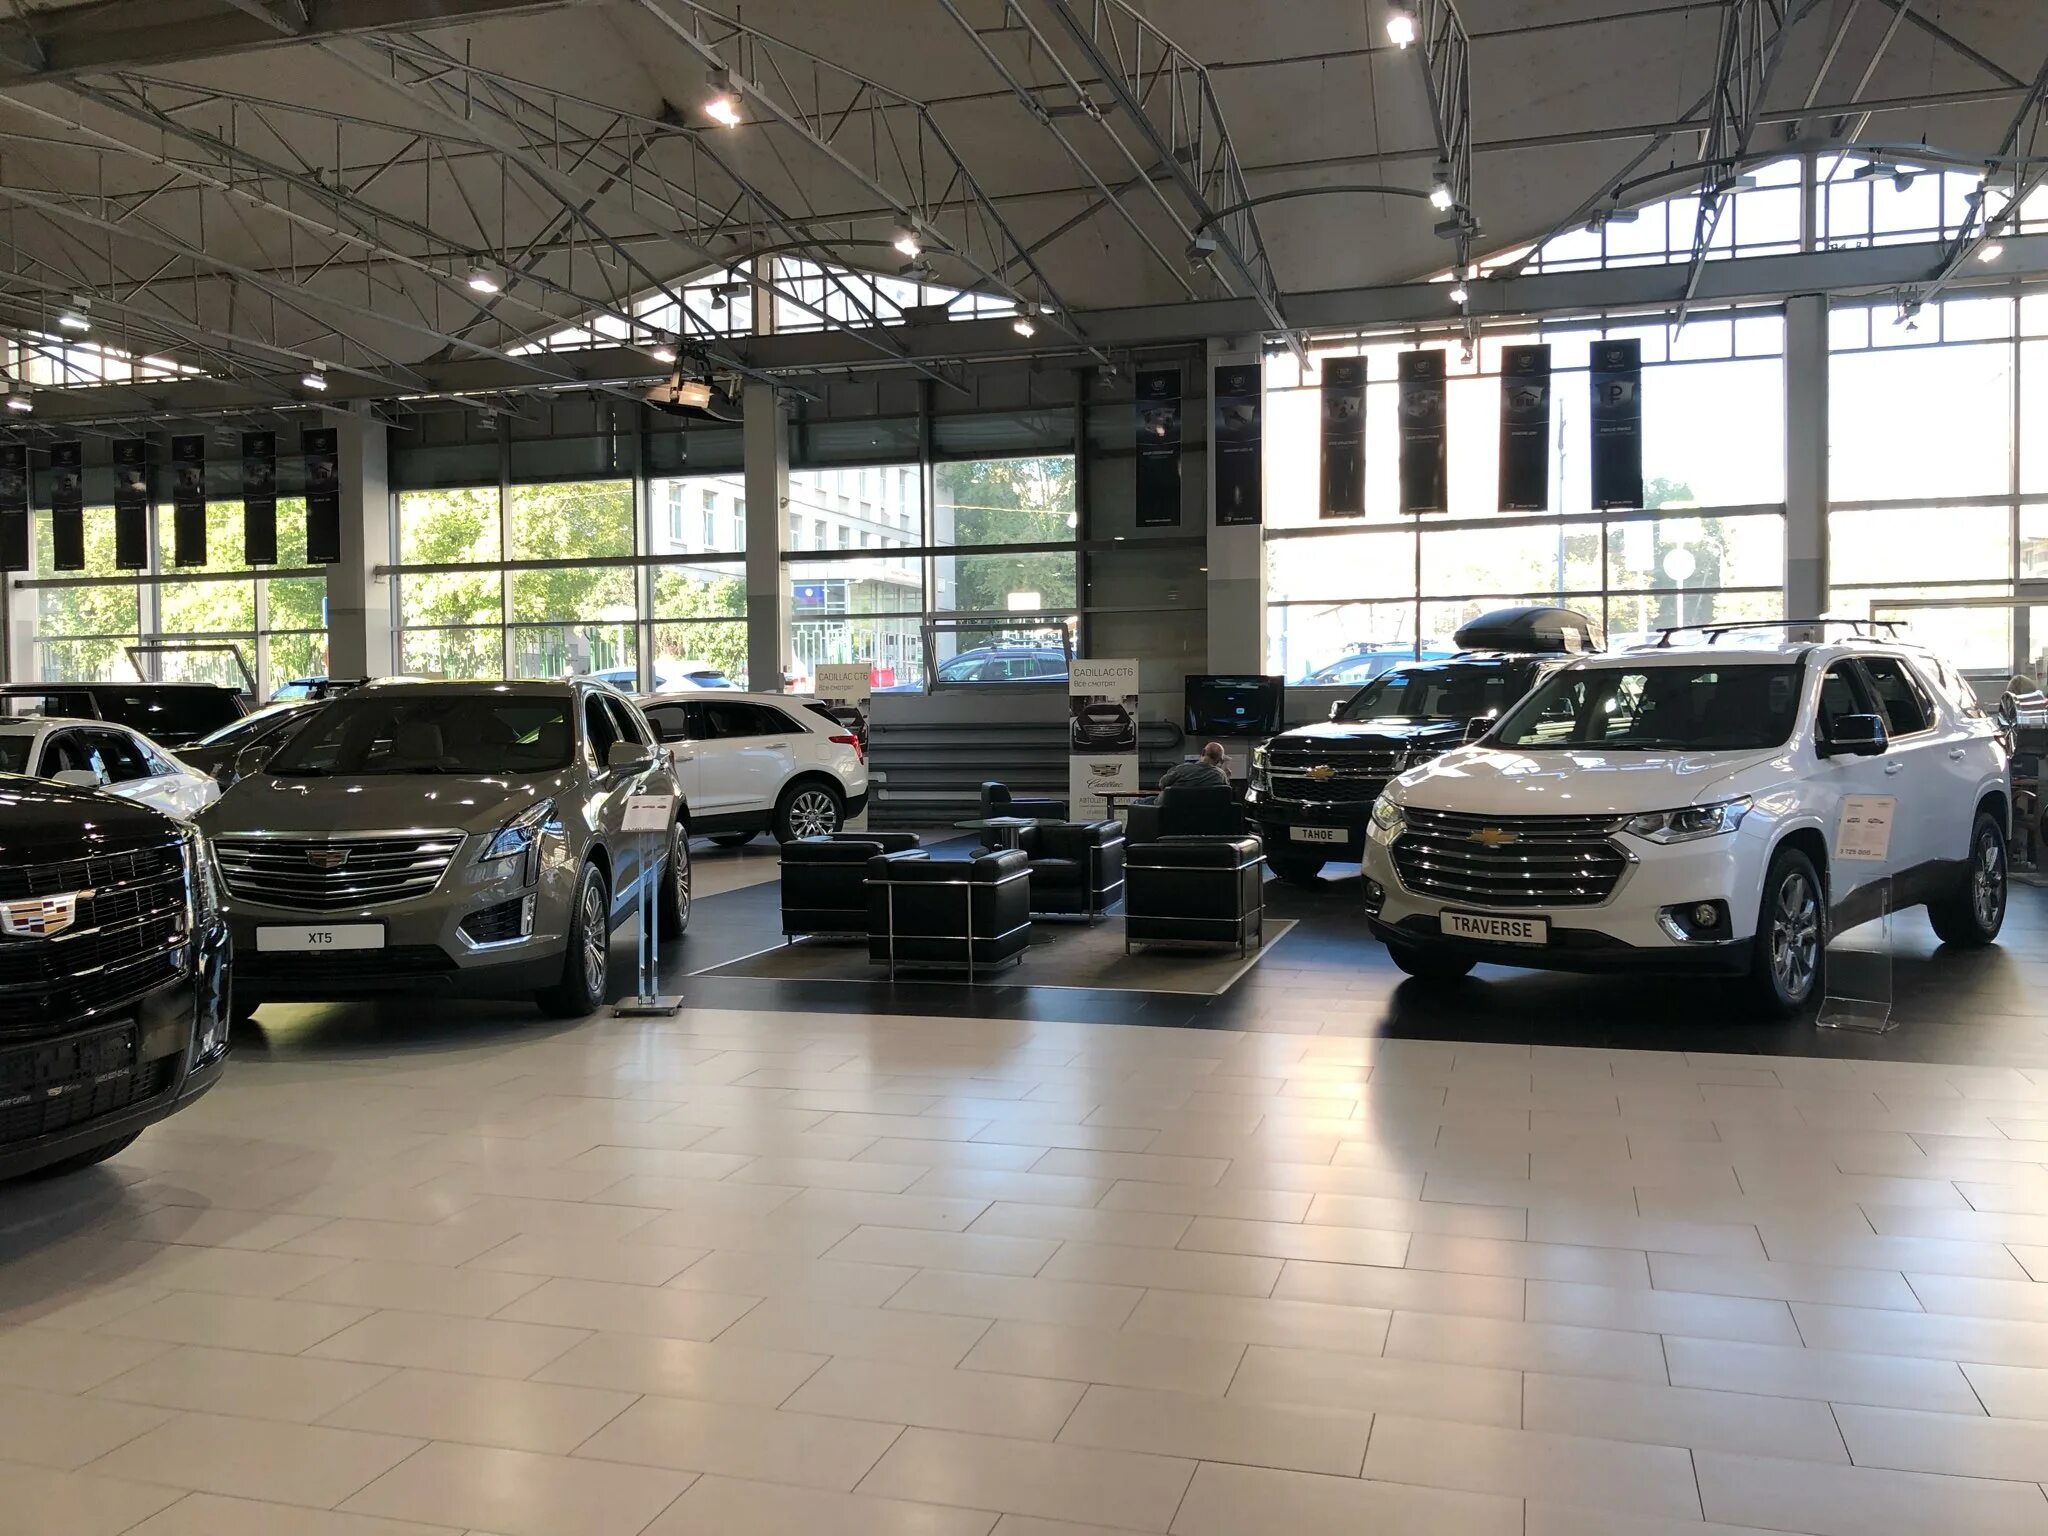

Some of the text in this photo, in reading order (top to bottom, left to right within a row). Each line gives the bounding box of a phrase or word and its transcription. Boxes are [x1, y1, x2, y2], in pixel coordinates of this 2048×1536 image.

[818, 672, 868, 681] CADILLAC CT6
[1073, 667, 1134, 677] CADILLAC CT6
[1073, 680, 1116, 688] Все смотрят
[1302, 829, 1333, 840] TAHOE
[1451, 915, 1533, 938] TRAVERSE
[308, 932, 332, 944] XT5
